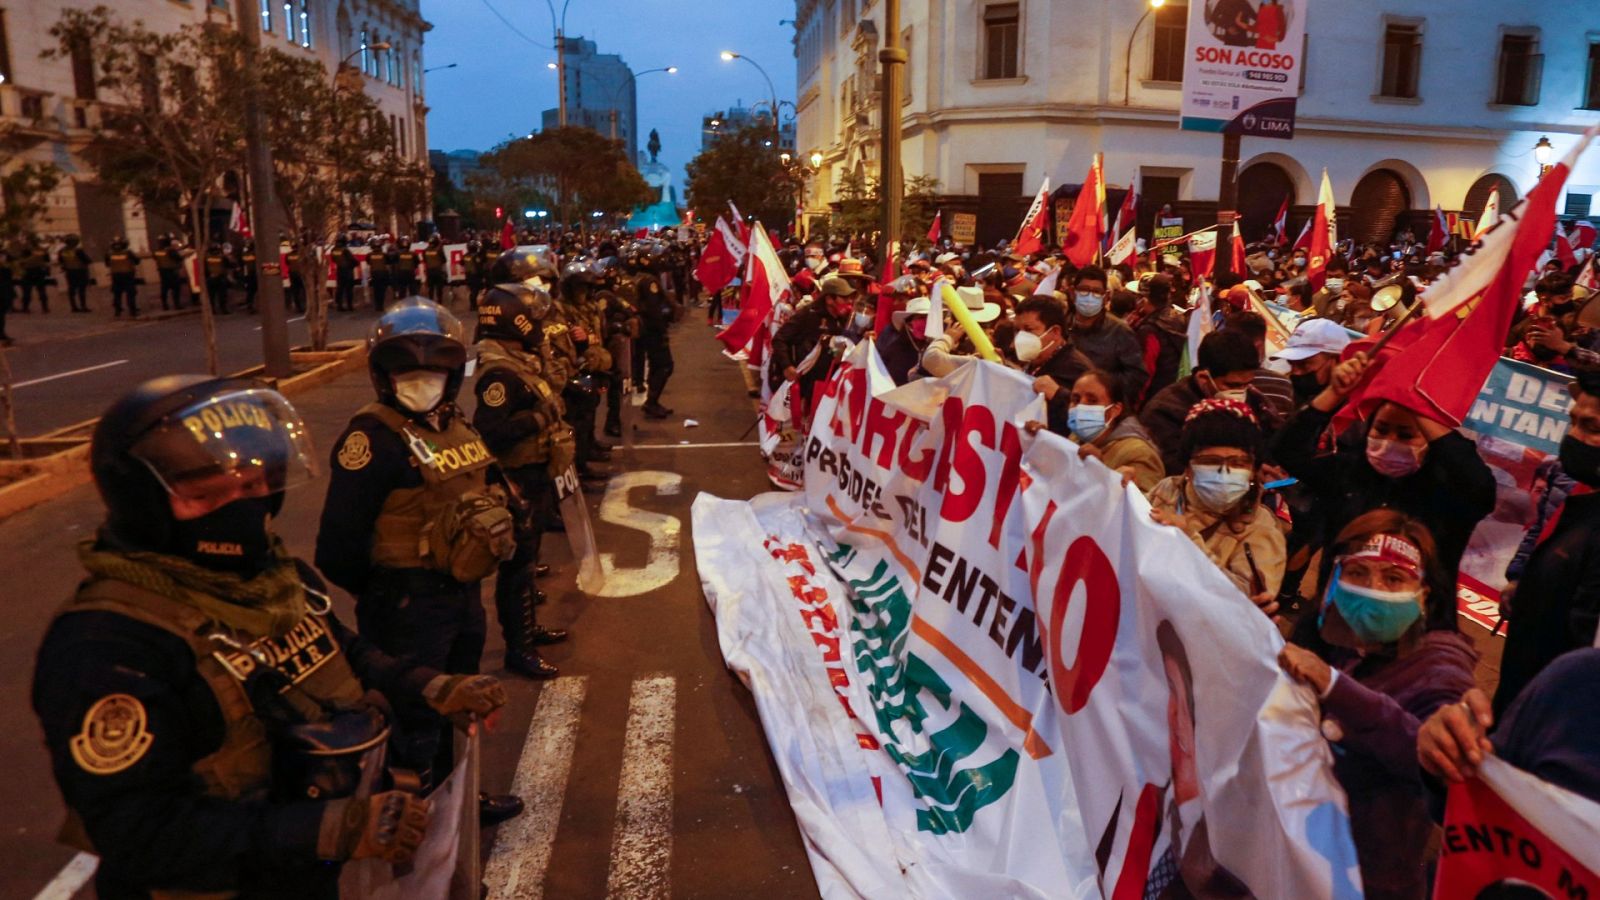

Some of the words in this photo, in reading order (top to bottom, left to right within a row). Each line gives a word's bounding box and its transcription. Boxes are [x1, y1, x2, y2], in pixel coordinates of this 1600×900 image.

[1195, 46, 1232, 64] SON
[1235, 50, 1294, 70] ACOSO
[1261, 121, 1290, 132] LIMA
[514, 314, 533, 336] GIR
[183, 402, 272, 444] POLICIA
[433, 440, 492, 474] POLICIA
[197, 540, 243, 556] POLICIA
[575, 469, 683, 598] S
[1441, 822, 1542, 870] ENTO
